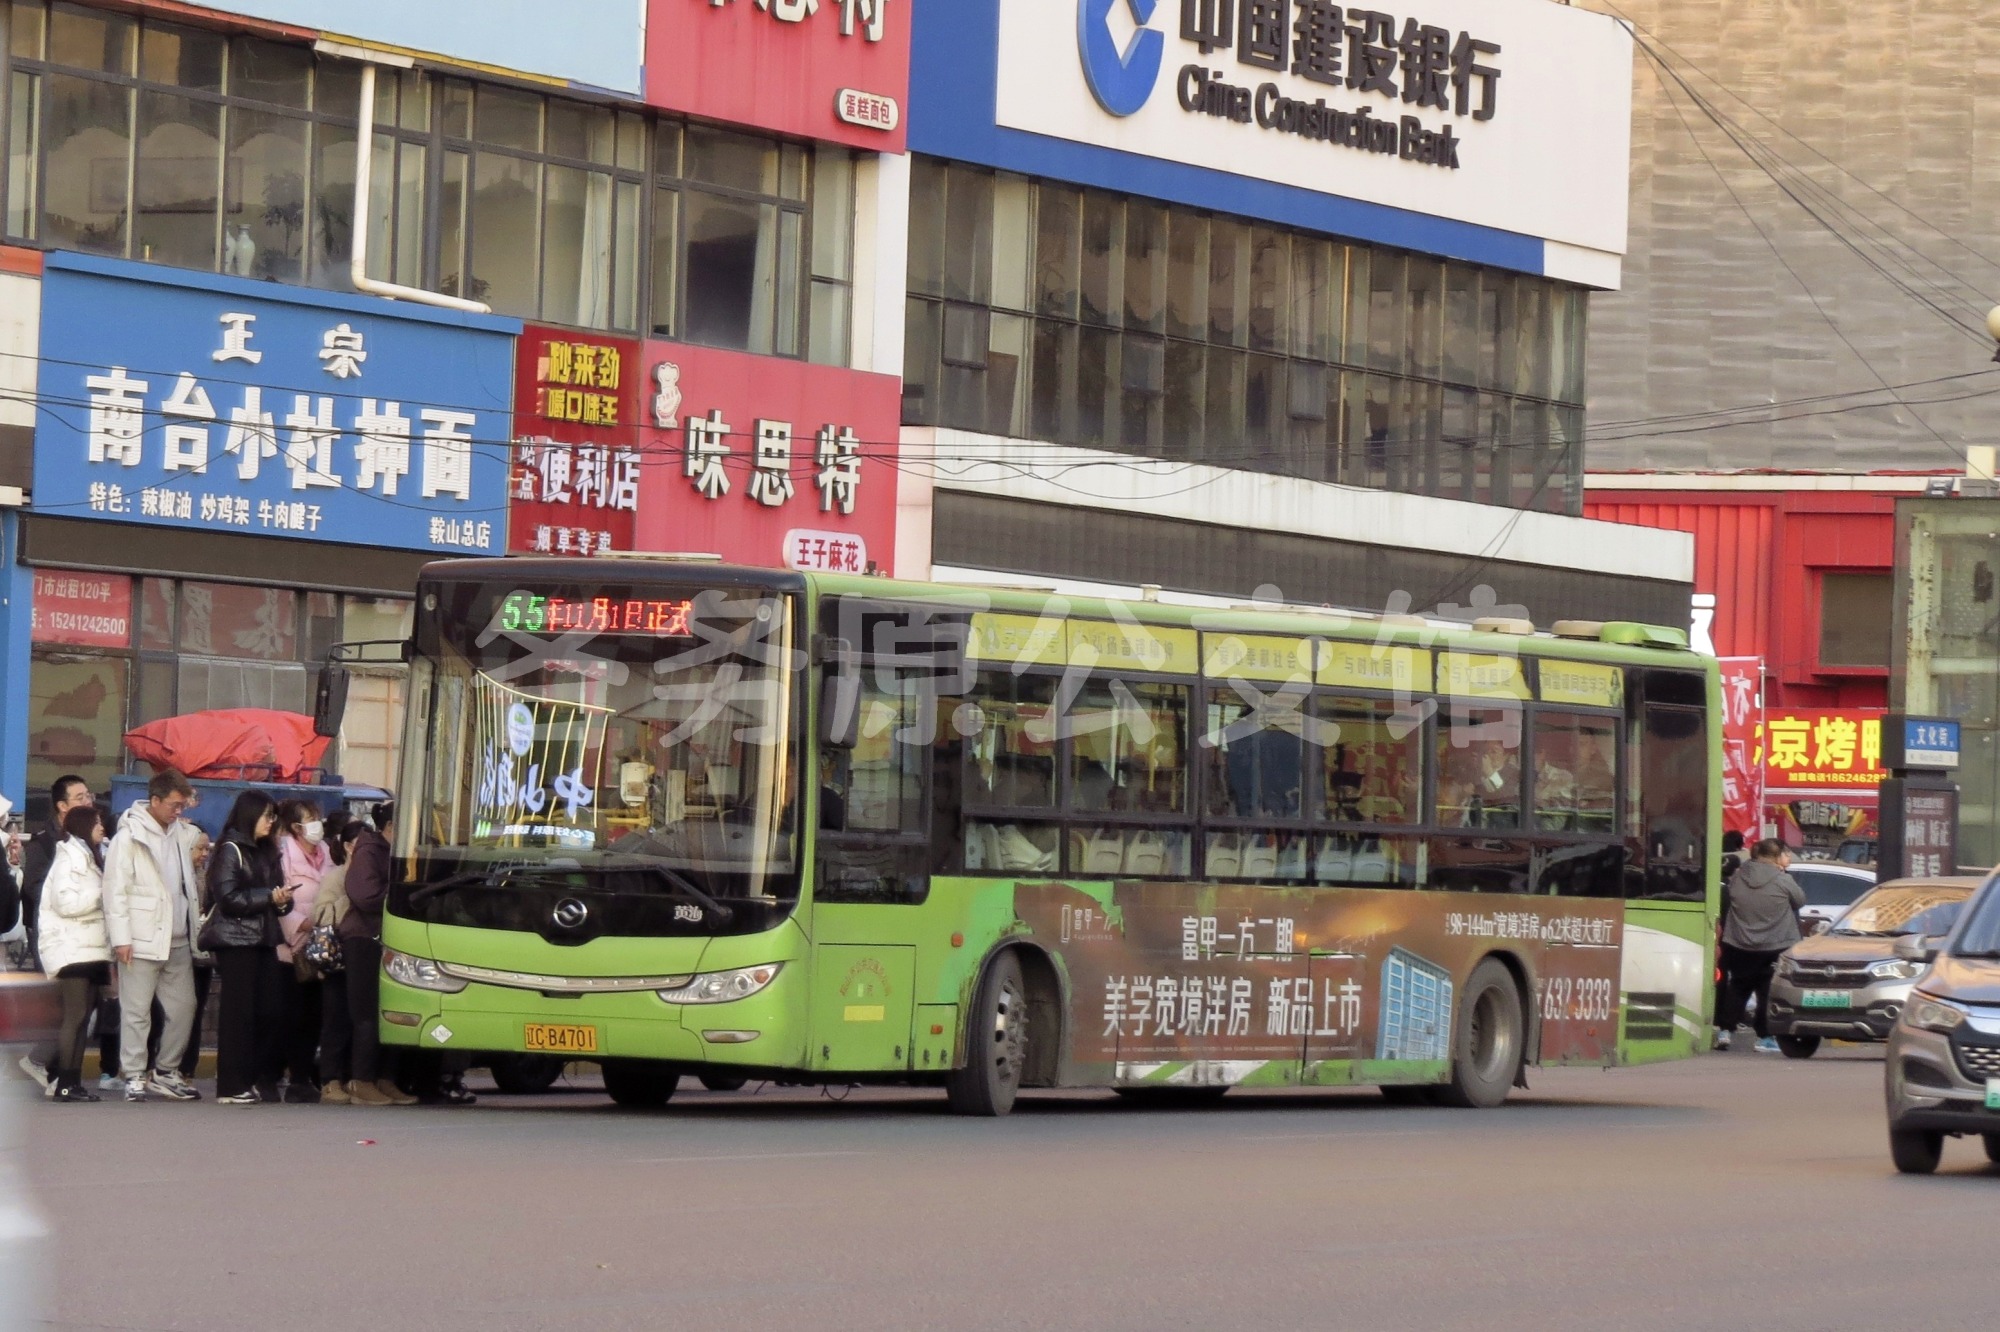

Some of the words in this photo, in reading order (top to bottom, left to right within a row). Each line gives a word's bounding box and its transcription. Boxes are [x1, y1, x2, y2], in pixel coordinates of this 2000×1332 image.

[1179, 0, 1502, 121] 中国建设银行
[845, 94, 890, 124] 蛋糕面包
[1177, 64, 1252, 123] China
[1255, 83, 1398, 155] Construction
[1399, 115, 1460, 169] Bank
[212, 312, 368, 379] 正宗
[86, 366, 476, 500] 南台小杜抻面
[540, 437, 641, 512] 便利店
[682, 409, 862, 515] 味思特
[141, 487, 192, 519] 辣椒油
[200, 493, 250, 526] 炒鸡架
[257, 498, 322, 532] 牛肉腱子
[429, 516, 491, 549] 鞍山总店
[534, 525, 612, 556] 烟草专卖
[797, 538, 859, 572] 王子麻花
[50, 611, 127, 635] 15241242500
[502, 595, 546, 631] 55
[1181, 915, 1294, 962] 富甲一方二期
[1102, 975, 1252, 1036] 美学宽境洋房
[1266, 976, 1362, 1036] 新品上市
[1575, 977, 1611, 1020] 3333
[434, 1026, 450, 1038] LNG
